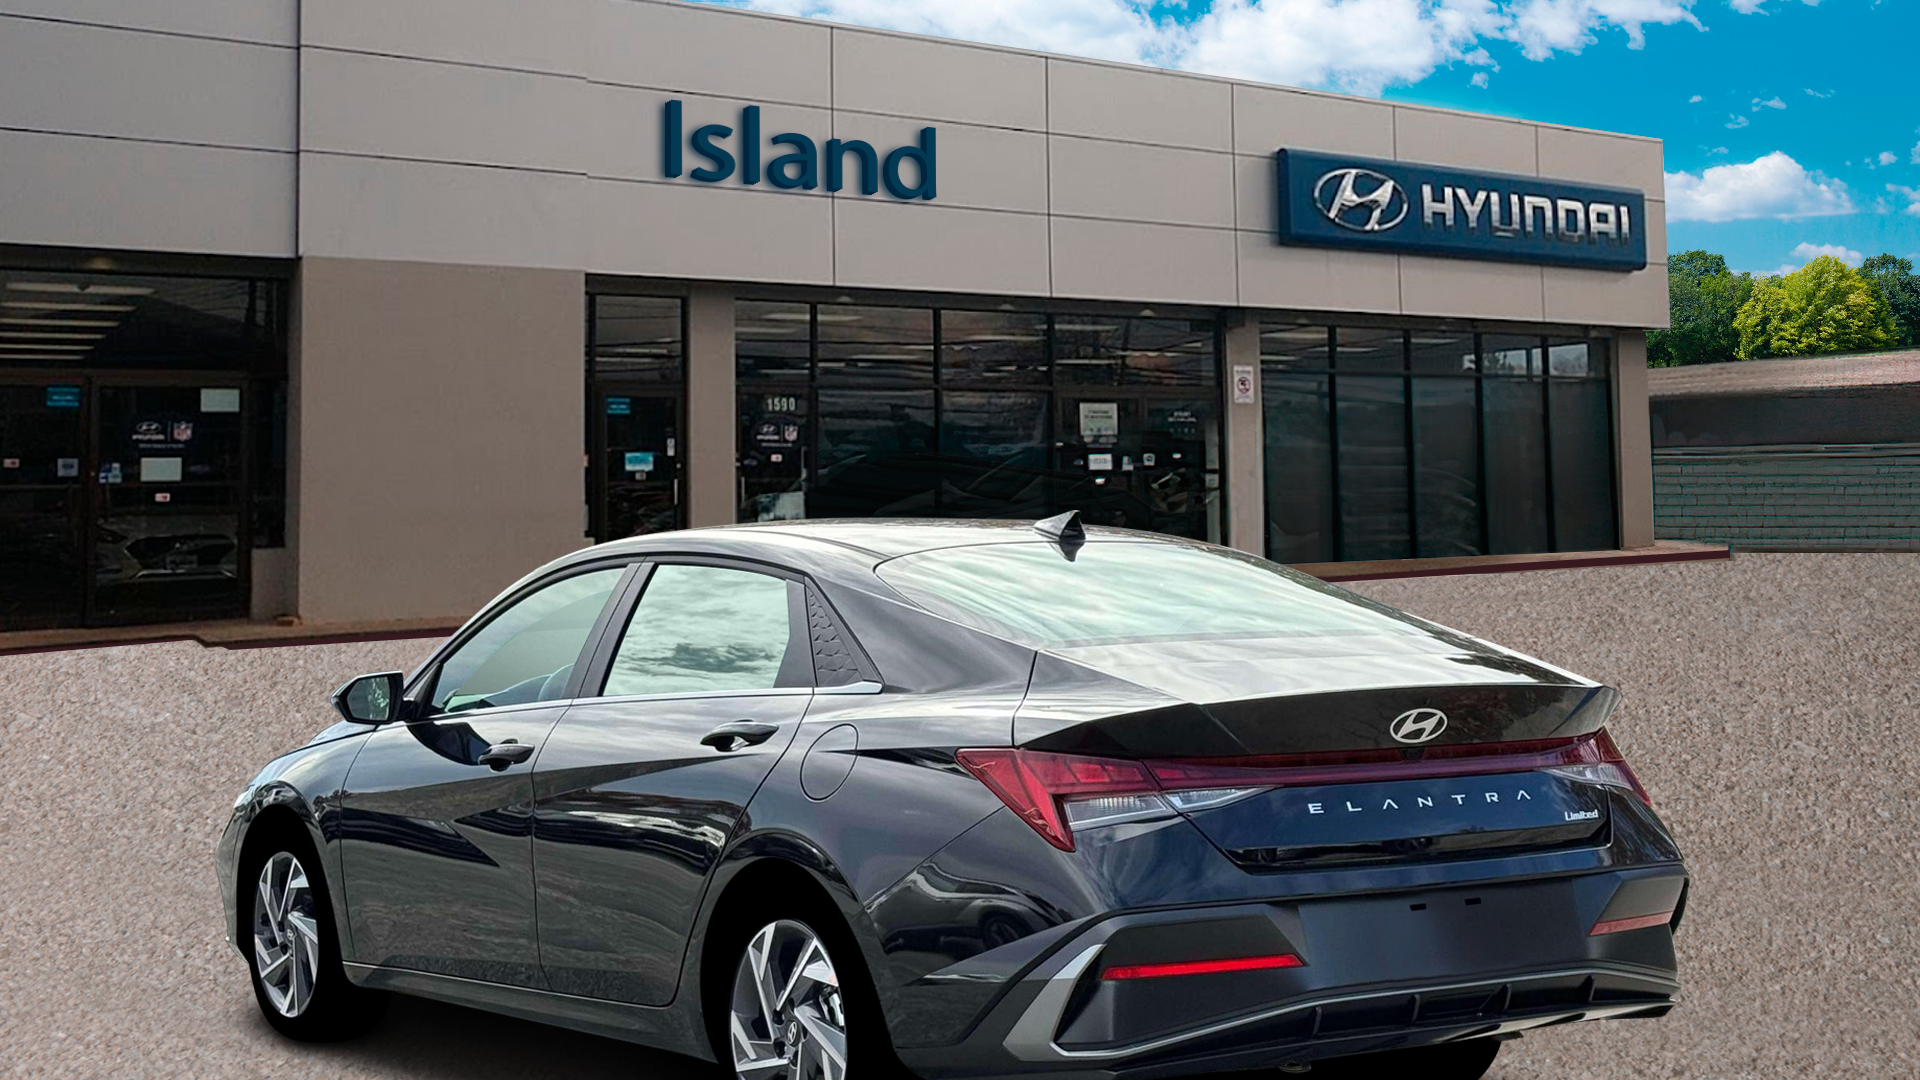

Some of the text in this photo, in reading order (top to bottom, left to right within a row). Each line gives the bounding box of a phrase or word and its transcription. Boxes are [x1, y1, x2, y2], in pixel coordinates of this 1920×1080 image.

[664, 99, 937, 201] Island
[1421, 183, 1630, 247] HYUNDAI
[766, 397, 796, 411] 1590
[1308, 790, 1532, 814] ELANTRA
[1564, 809, 1599, 822] Limited
